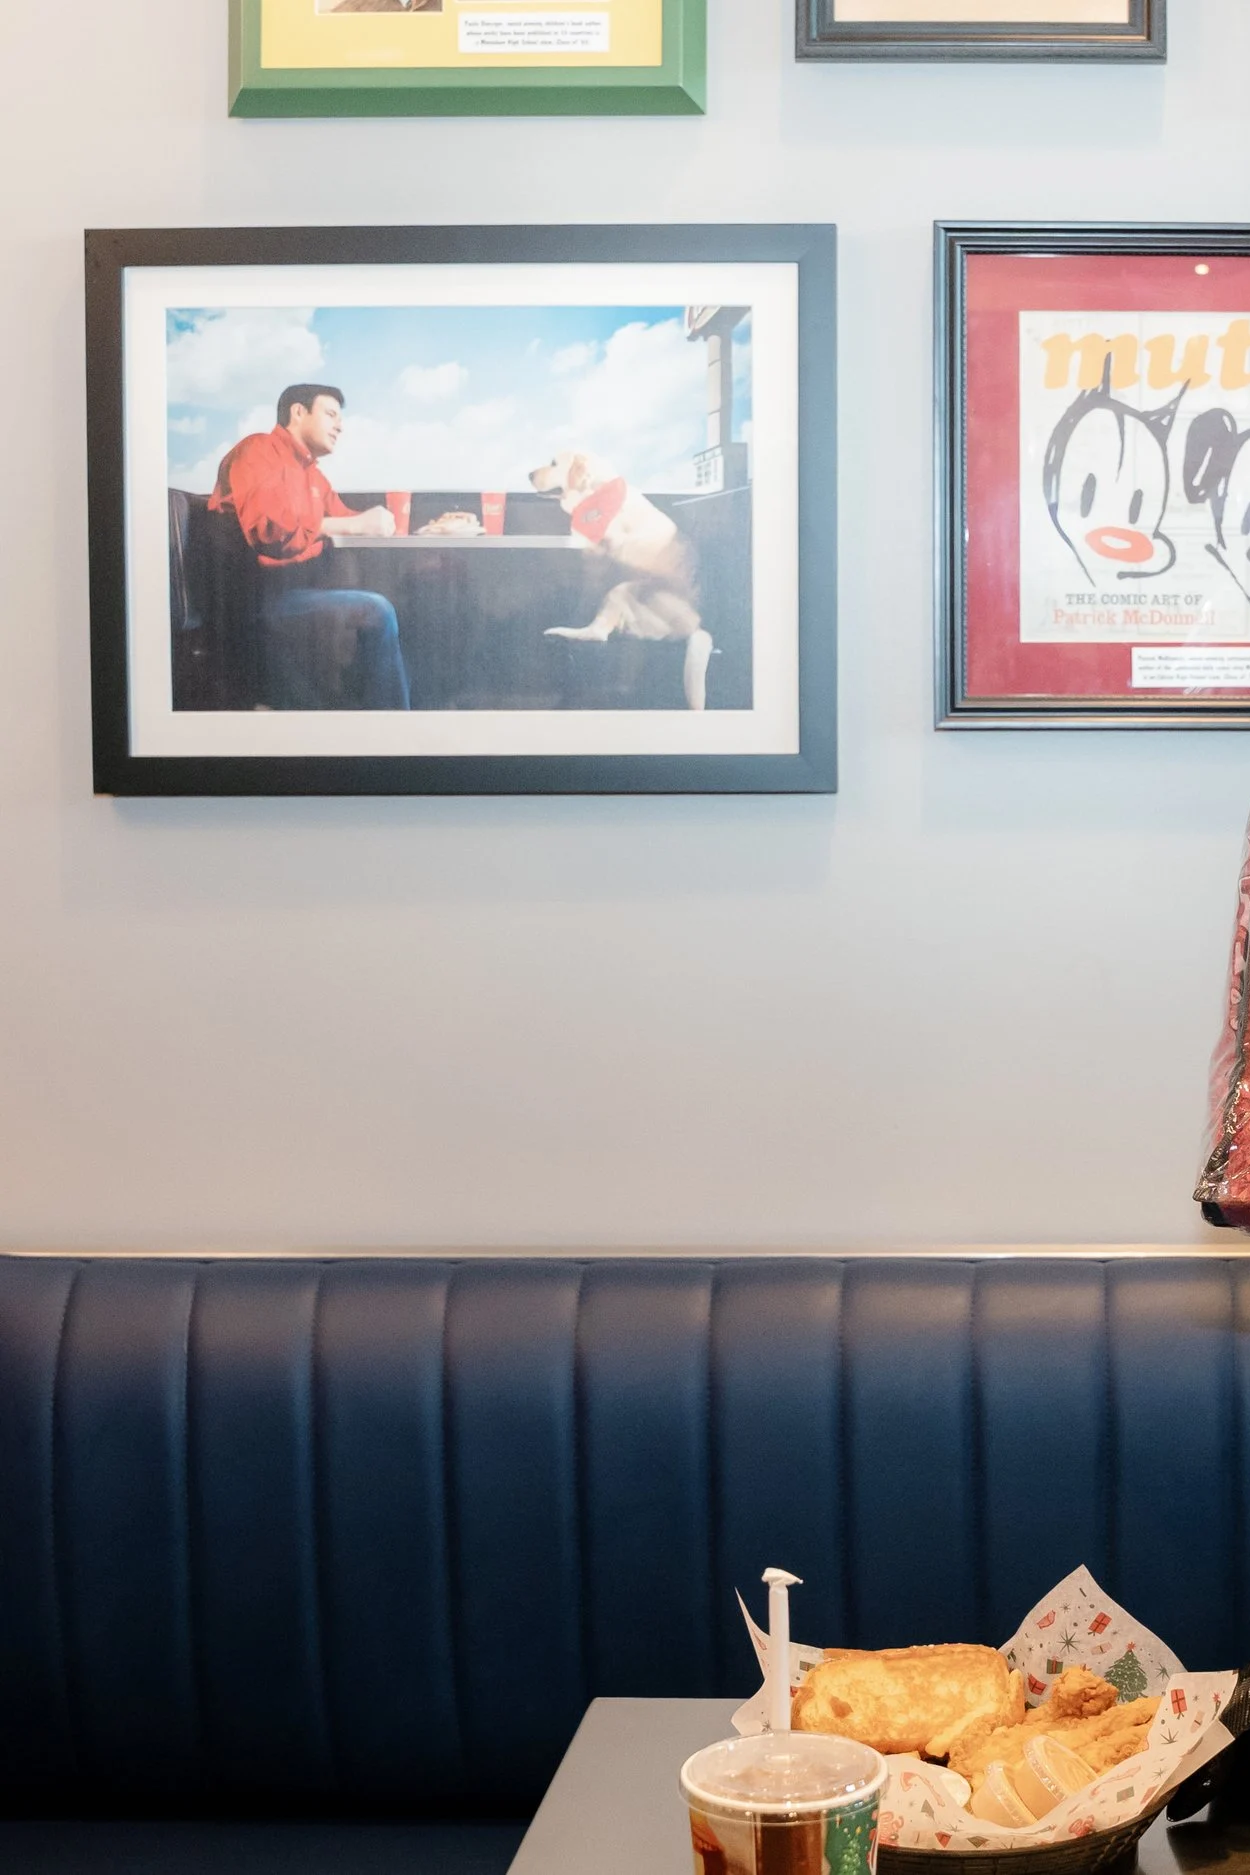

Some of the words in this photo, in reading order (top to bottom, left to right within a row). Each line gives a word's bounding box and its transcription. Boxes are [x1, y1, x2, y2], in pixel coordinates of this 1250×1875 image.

[1066, 593, 1096, 605] THE
[1100, 593, 1148, 605] COMIC
[1150, 594, 1181, 606] ART
[1184, 594, 1204, 606] OF
[1053, 608, 1116, 625] Patrick
[1123, 608, 1216, 625] McDonnl
